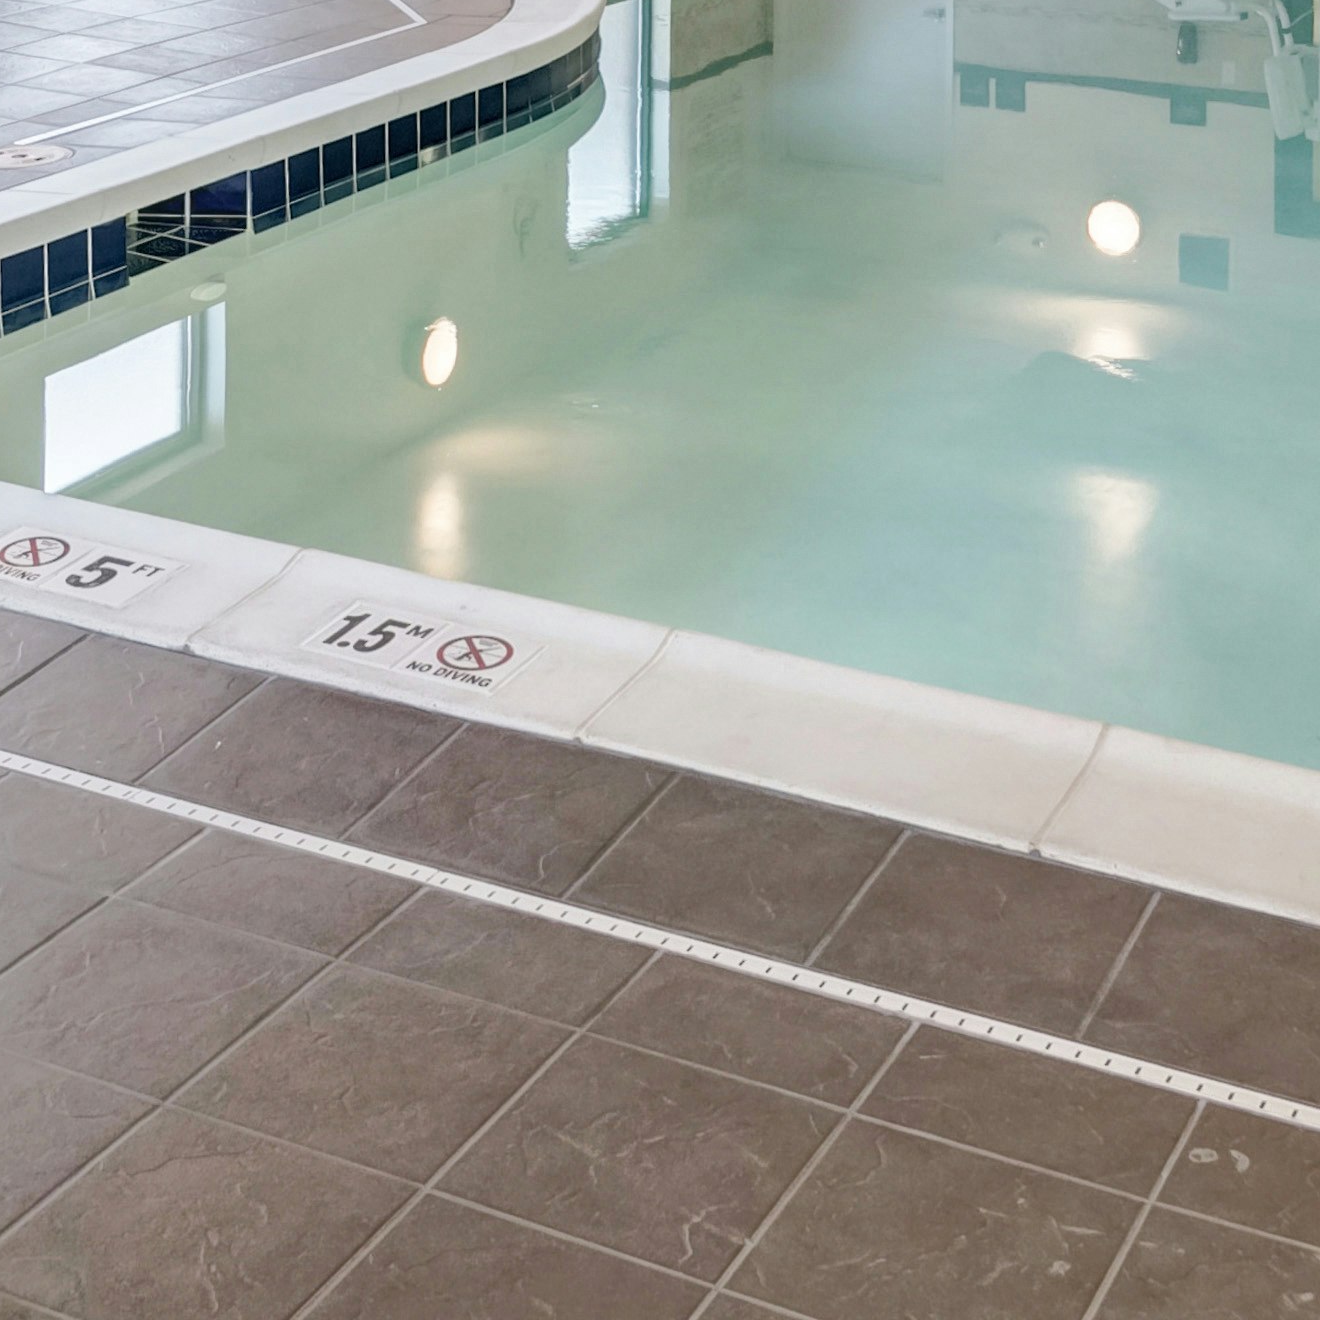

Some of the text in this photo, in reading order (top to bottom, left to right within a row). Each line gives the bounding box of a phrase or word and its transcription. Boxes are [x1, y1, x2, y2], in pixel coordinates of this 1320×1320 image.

[65, 555, 165, 589] 5 FT
[322, 612, 434, 653] 1.5 M
[406, 660, 493, 688] NO DIVING
